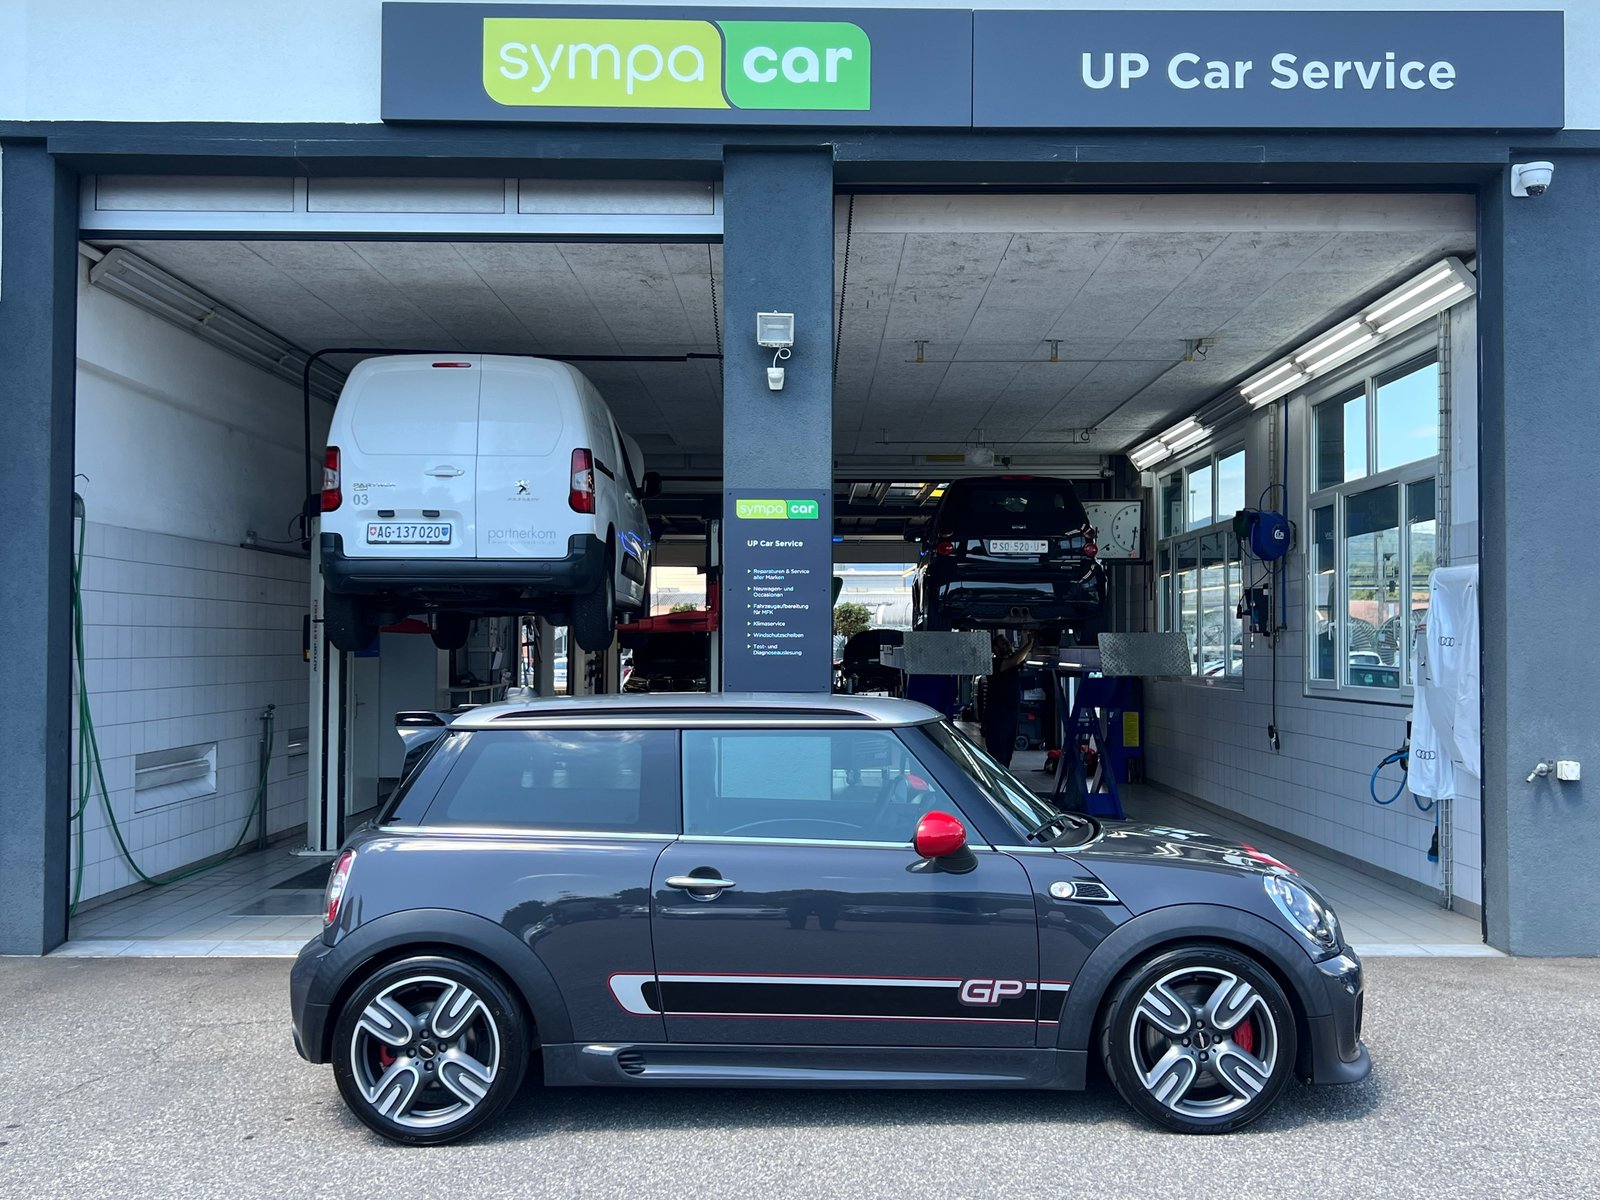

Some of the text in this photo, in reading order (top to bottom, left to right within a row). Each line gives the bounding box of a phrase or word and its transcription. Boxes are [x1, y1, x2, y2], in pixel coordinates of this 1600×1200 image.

[499, 41, 853, 95] sympa car
[1082, 52, 1456, 90] UP Car Service
[353, 494, 369, 506] 03
[740, 503, 815, 516] sympa car
[488, 525, 556, 544] partnerkom
[747, 540, 804, 548] UP Car Service
[961, 979, 1023, 1003] GP
